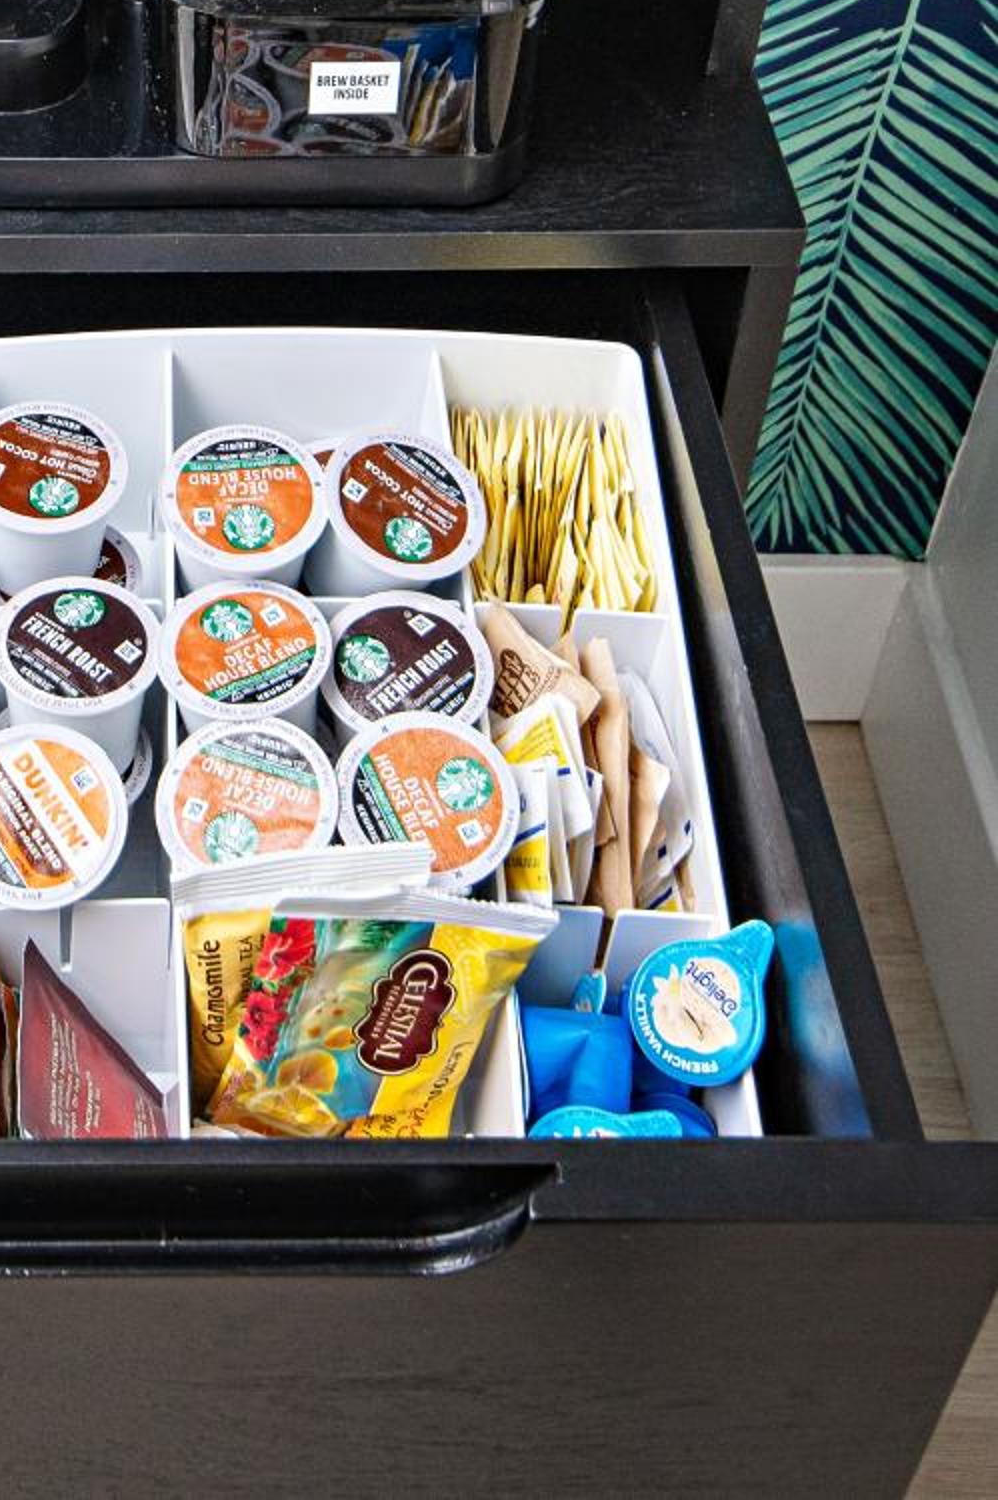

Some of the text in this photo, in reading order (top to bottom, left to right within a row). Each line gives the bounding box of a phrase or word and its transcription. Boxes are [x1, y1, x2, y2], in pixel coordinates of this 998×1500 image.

[317, 75, 390, 87] BREW BASKET
[333, 88, 369, 100] INSIDE
[39, 455, 67, 470] HOT
[188, 467, 298, 485] HOUSE BLEND
[364, 460, 401, 494] COCOA
[218, 481, 270, 497] DECAF
[400, 489, 425, 512] HOT
[20, 615, 75, 656] FRENCH
[65, 646, 114, 683] ROAST
[202, 663, 259, 691] HOUSE
[258, 637, 308, 671] BLEND
[223, 637, 276, 668] DECAF
[369, 671, 424, 716] FRENCH
[414, 639, 460, 677] ROAST
[202, 756, 254, 786] BLEND
[373, 753, 412, 811] HOUSE
[12, 751, 91, 851] DUNKIN'
[225, 784, 277, 810] DECAF
[254, 772, 312, 805] HOUSE
[403, 775, 440, 829] DECAF
[239, 935, 253, 962] TEA
[197, 938, 226, 1048] Chamomile
[685, 960, 737, 1018] Delight
[373, 961, 439, 1061] CELESTIAL
[634, 992, 720, 1074] FRENCH VANILLA
